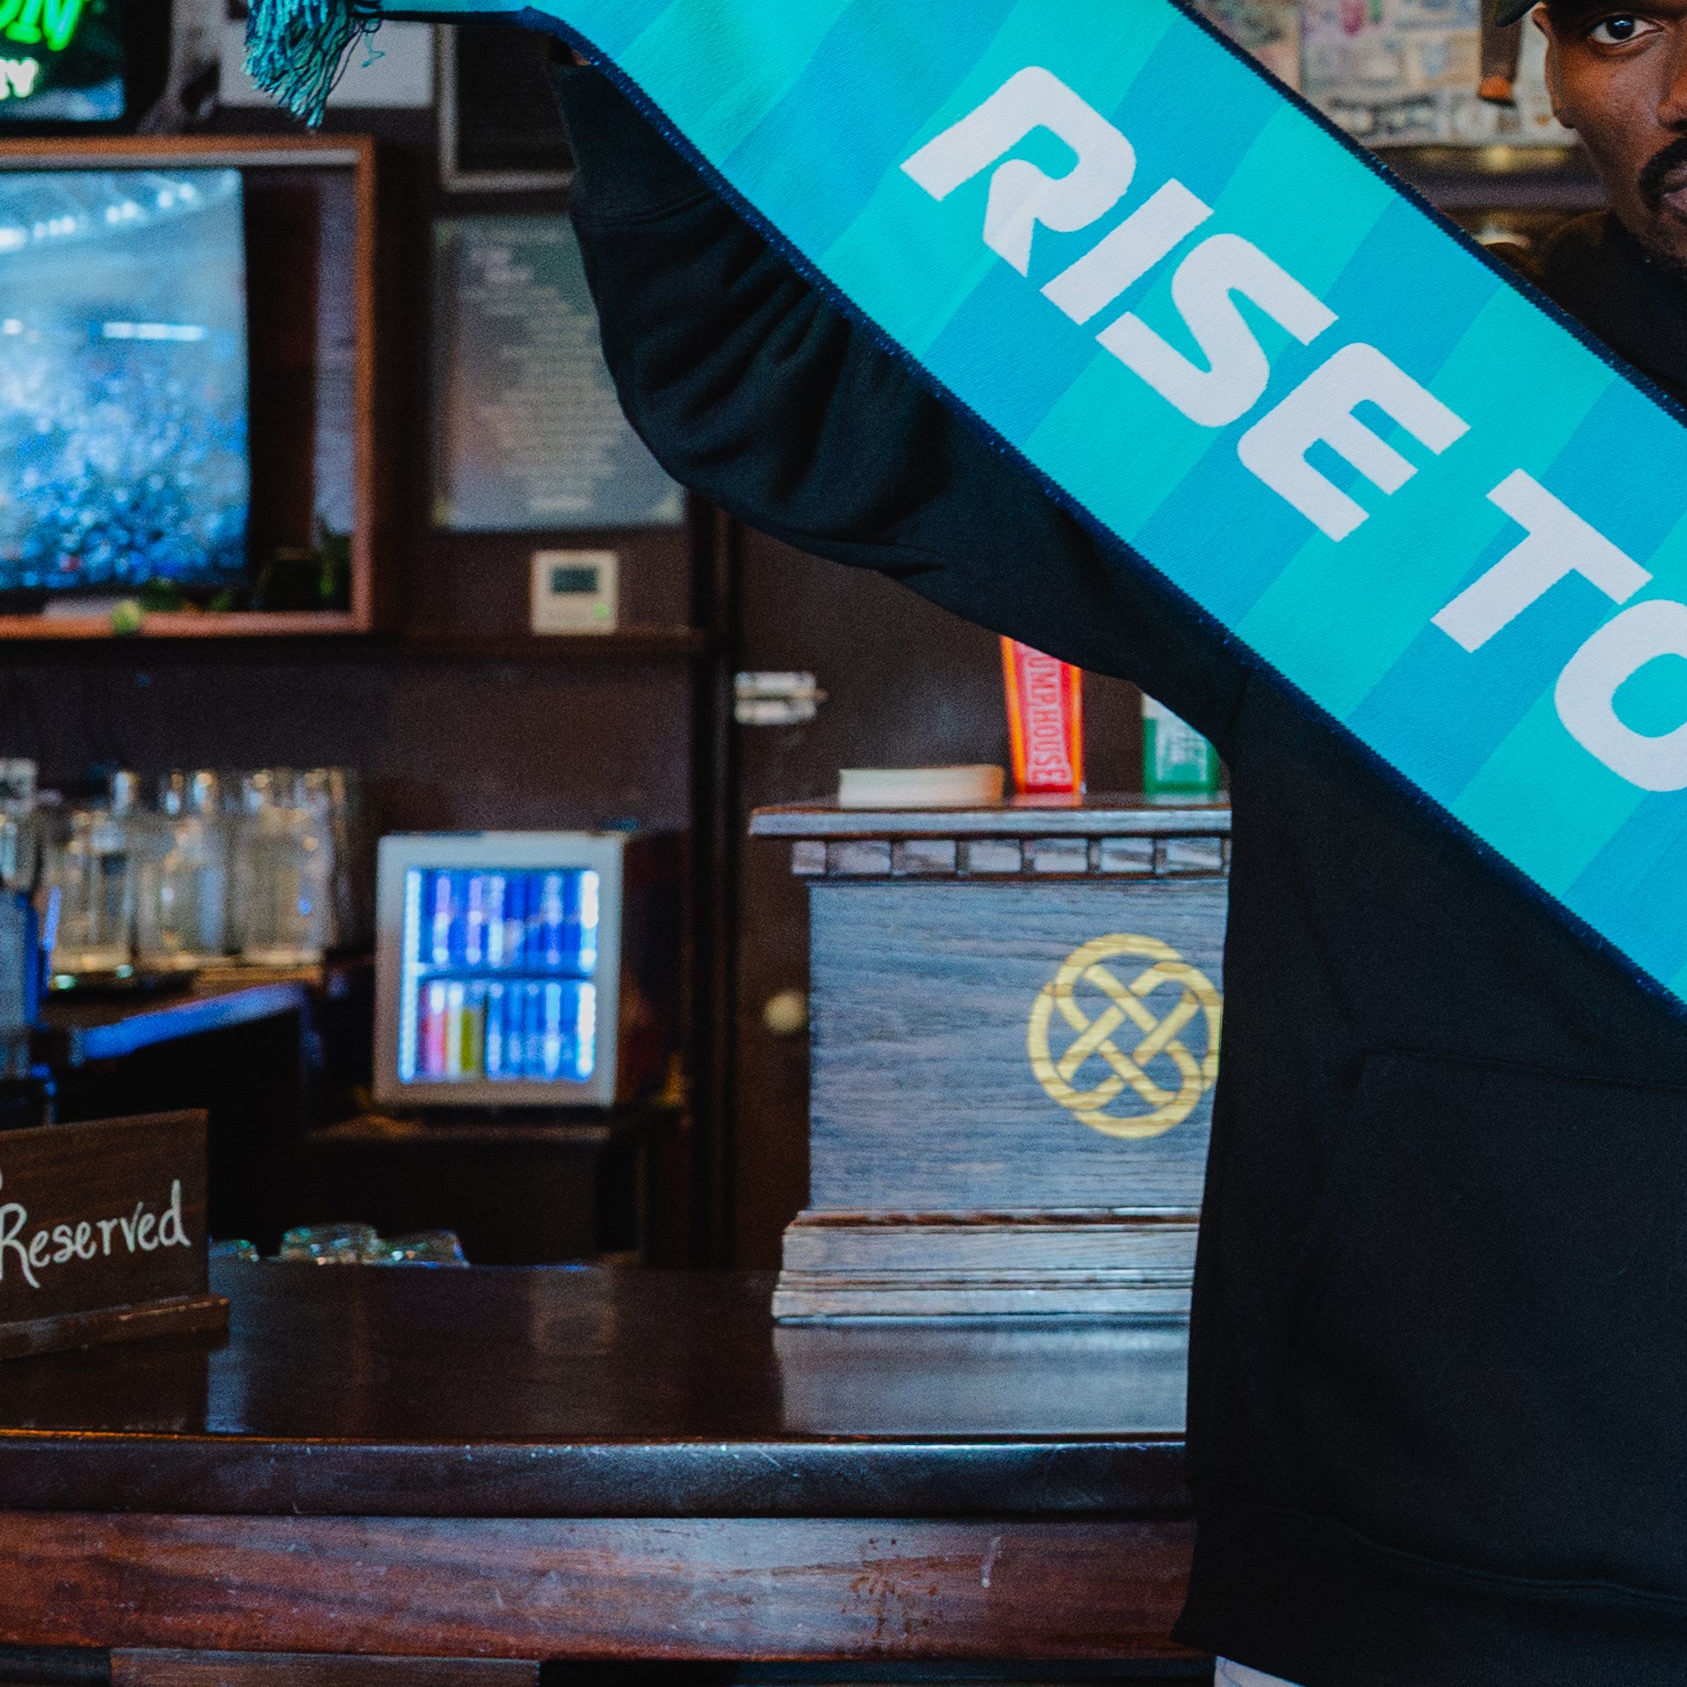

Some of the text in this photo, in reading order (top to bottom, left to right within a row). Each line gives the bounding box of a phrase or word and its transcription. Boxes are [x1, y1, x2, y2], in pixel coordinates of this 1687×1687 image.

[900, 66, 1471, 543] RISE
[1026, 650, 1069, 783] UMPHOUSE
[0, 1179, 191, 1288] Reserved
